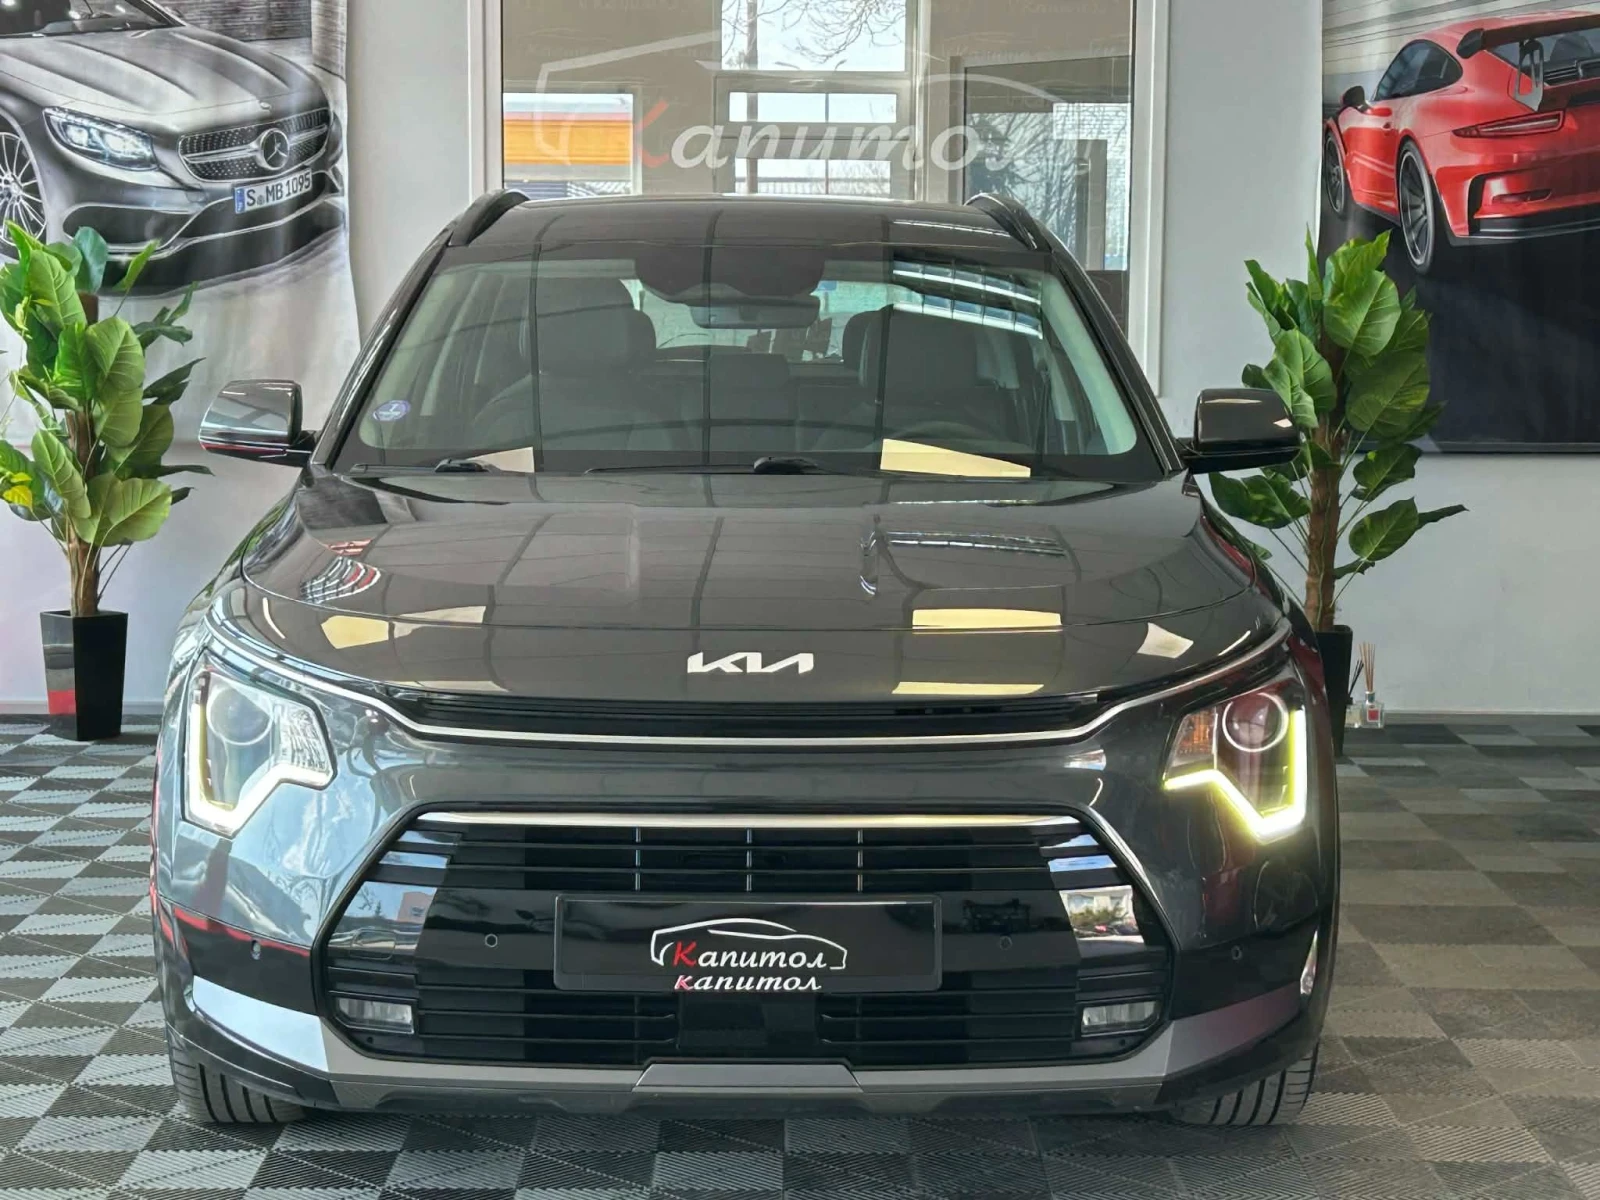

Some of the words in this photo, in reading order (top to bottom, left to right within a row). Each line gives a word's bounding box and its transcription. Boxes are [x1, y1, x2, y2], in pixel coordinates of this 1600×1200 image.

[246, 189, 256, 206] S
[687, 651, 814, 674] KIA
[672, 940, 827, 969] Капитол
